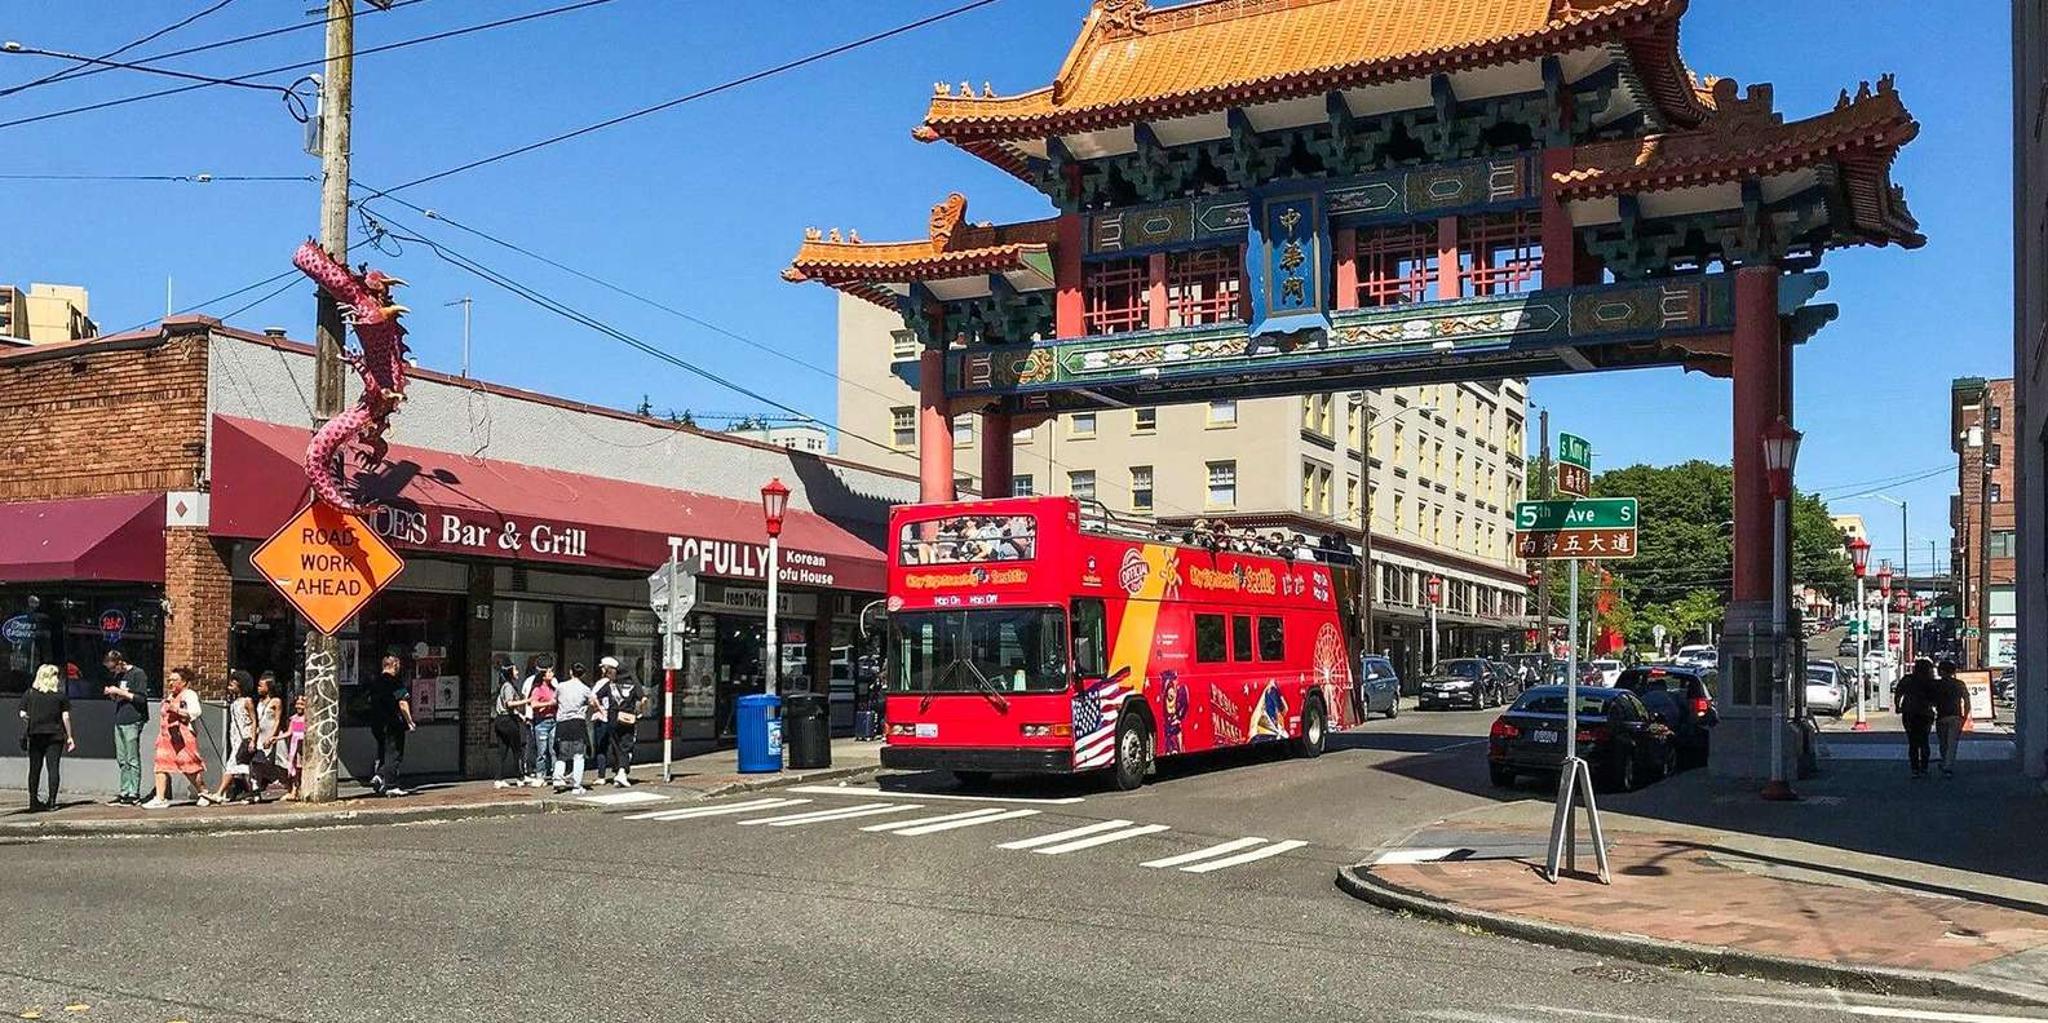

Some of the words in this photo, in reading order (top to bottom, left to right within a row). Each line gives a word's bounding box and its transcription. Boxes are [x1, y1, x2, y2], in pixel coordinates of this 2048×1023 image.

[1561, 440, 1567, 457] S
[1521, 505, 1551, 527] 5th
[1565, 508, 1595, 522] Ave
[1620, 506, 1631, 521] S
[302, 528, 354, 546] ROAD
[440, 514, 491, 547] Bar
[498, 521, 522, 550] &
[530, 525, 586, 557] Grill
[1519, 532, 1632, 554] 南第五大道
[301, 554, 354, 573] WORK
[668, 536, 770, 578] TOFULLY
[786, 550, 826, 567] Korean
[776, 566, 799, 581] ofu
[800, 569, 834, 585] House
[294, 579, 362, 596] AHEAD
